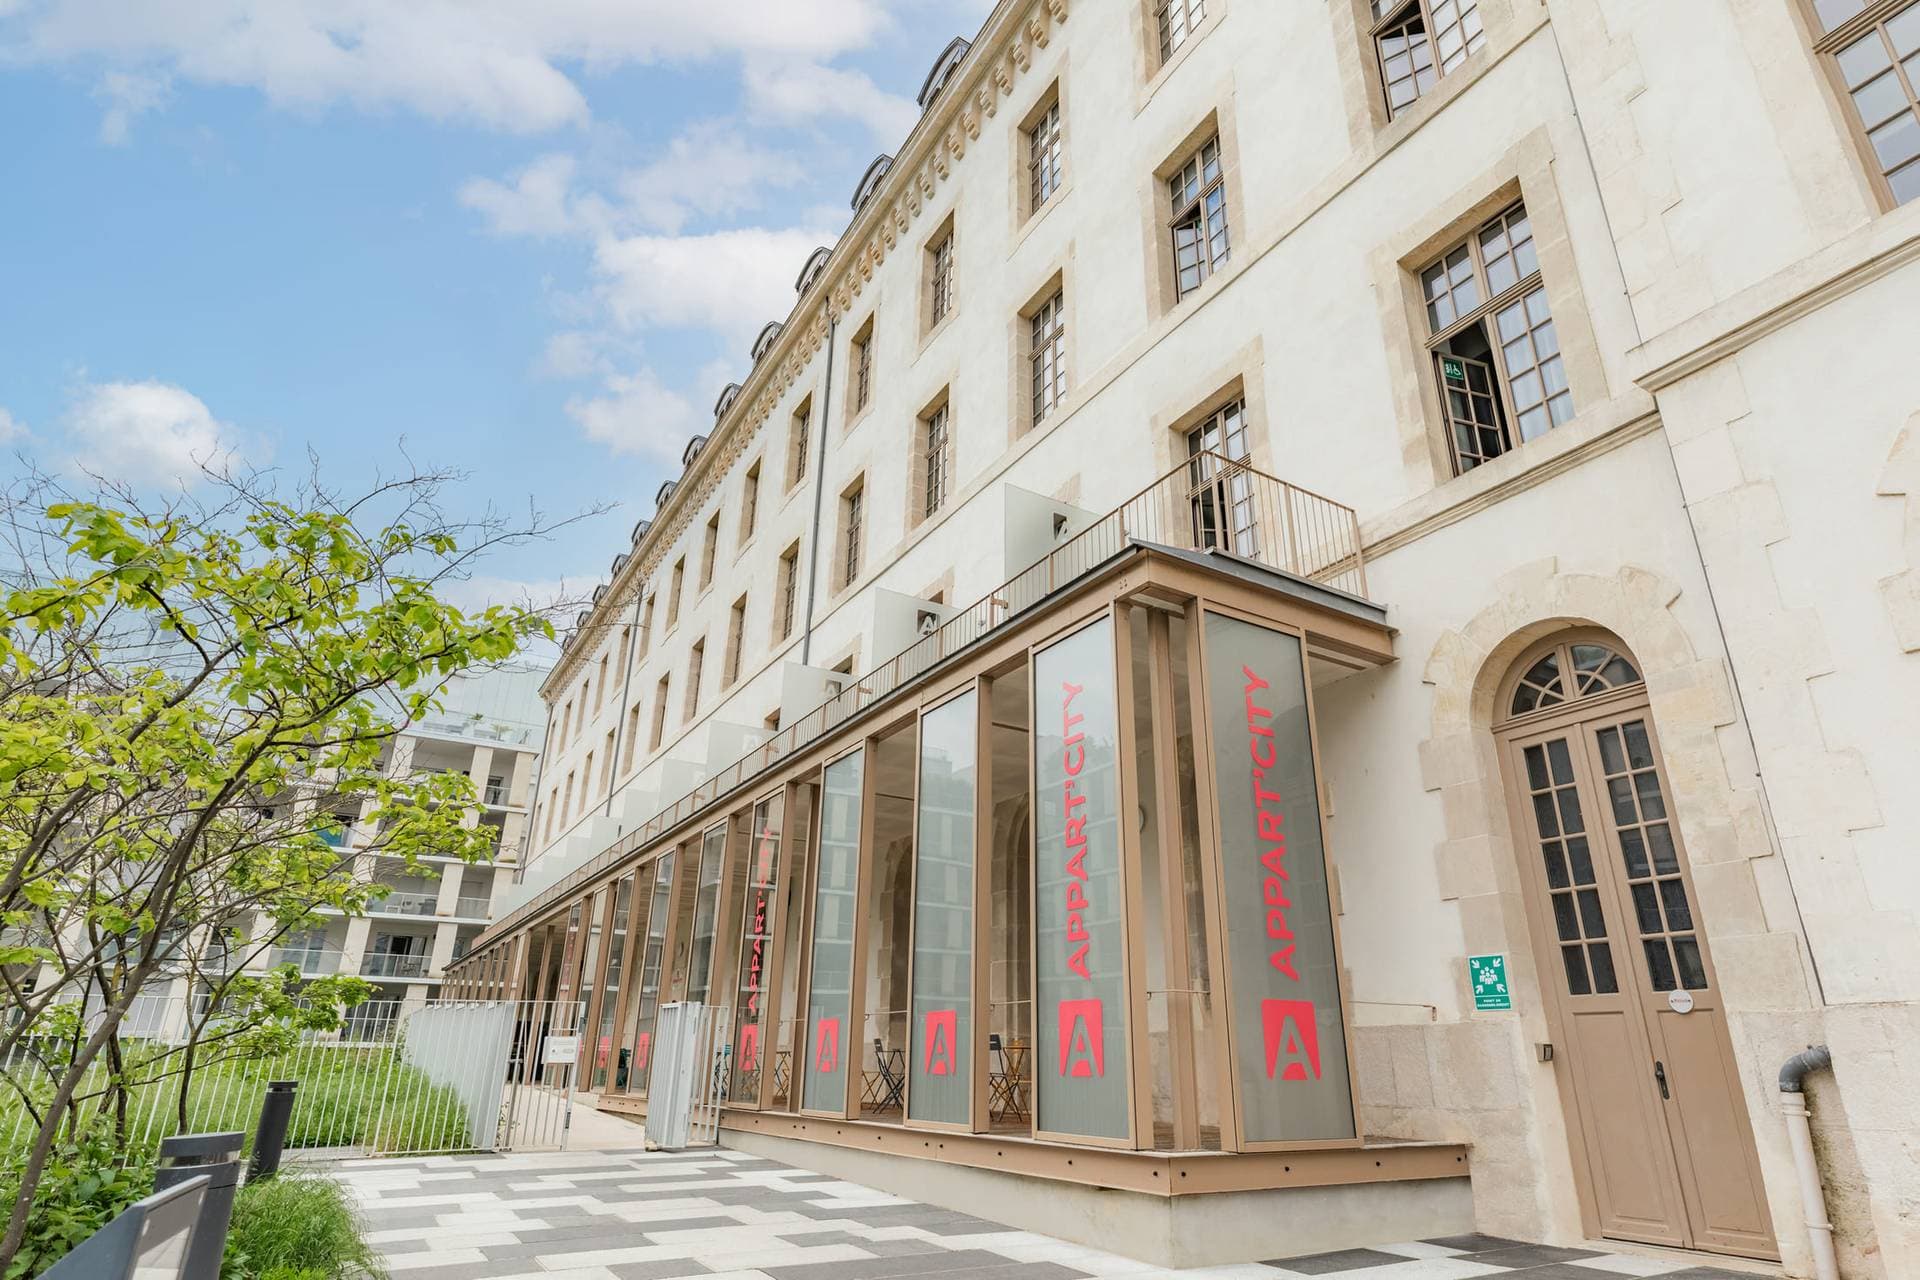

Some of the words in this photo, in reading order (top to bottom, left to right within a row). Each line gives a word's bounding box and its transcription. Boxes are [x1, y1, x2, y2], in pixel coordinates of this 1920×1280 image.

[1062, 681, 1092, 980] APPART'CITY
[1242, 665, 1300, 981] APPART'CITY
[927, 1022, 954, 1075] A
[1063, 1013, 1102, 1077] A
[1269, 1013, 1316, 1080] A
